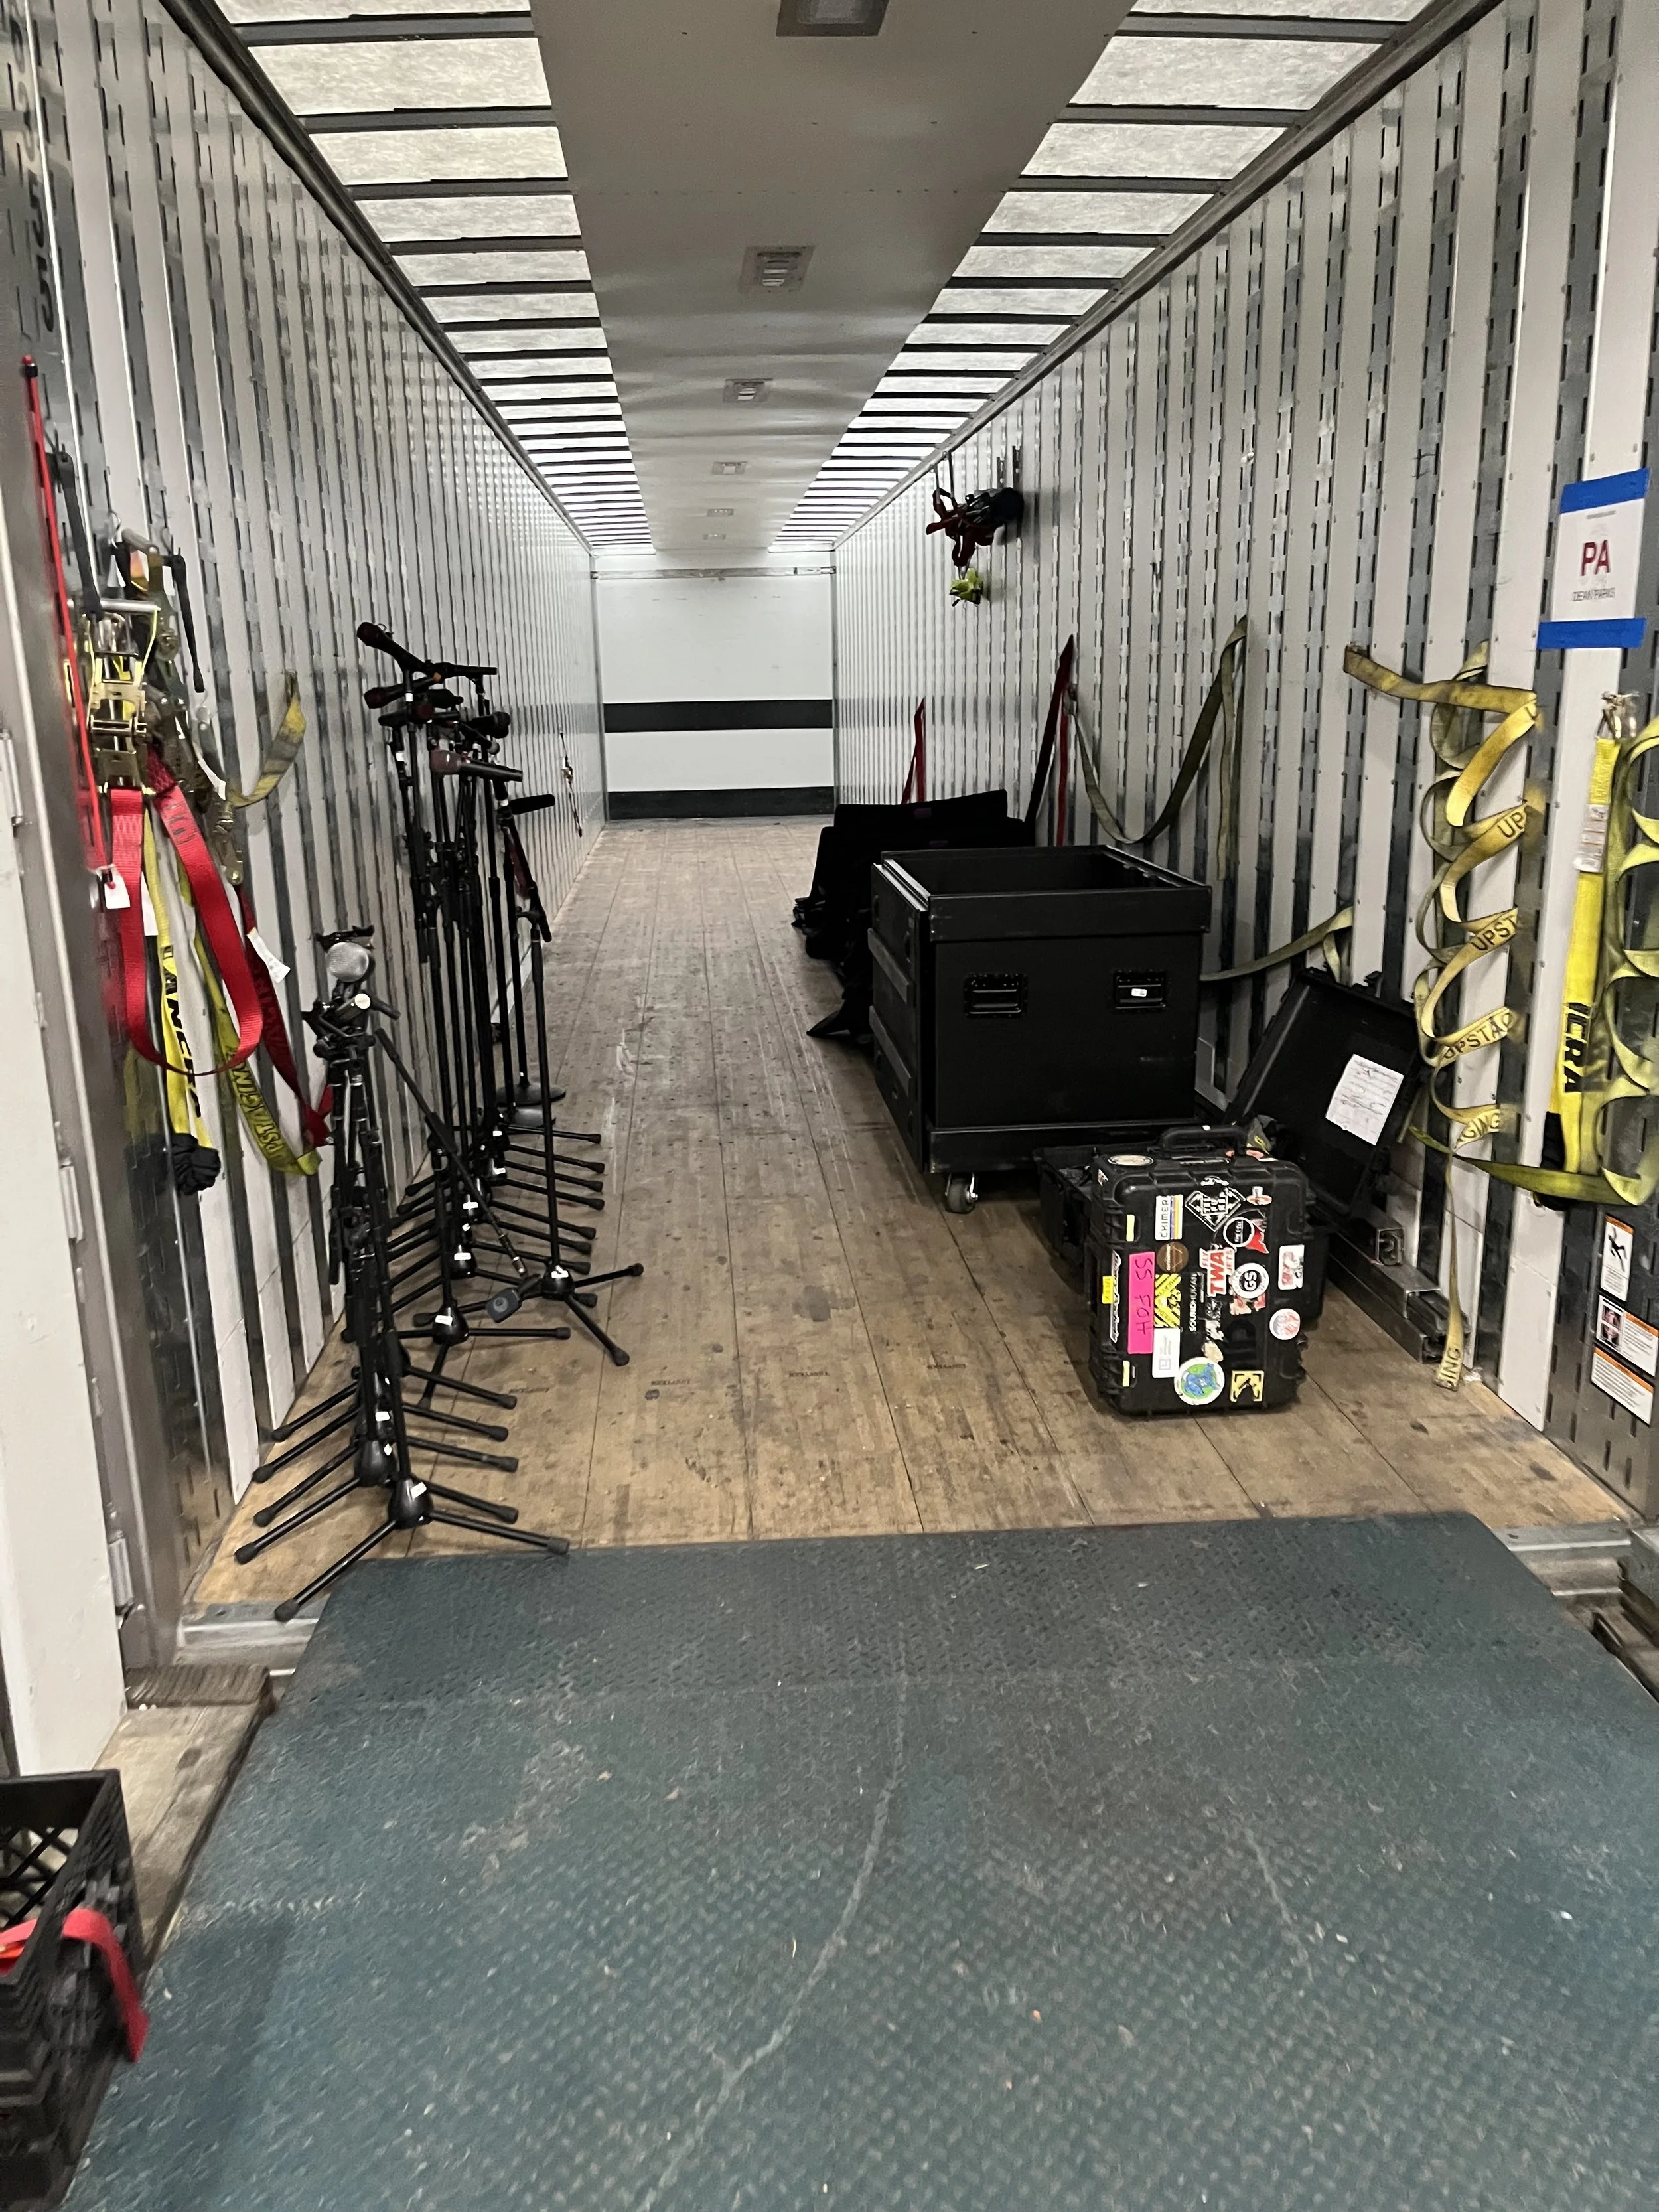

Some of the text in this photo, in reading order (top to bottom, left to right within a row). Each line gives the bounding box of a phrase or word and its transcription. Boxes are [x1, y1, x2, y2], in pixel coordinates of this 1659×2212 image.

[1579, 540, 1611, 576] PA
[1498, 812, 1524, 838] UP
[1210, 1252, 1224, 1294] TWA
[1244, 1270, 1257, 1291] GS
[1135, 1258, 1153, 1335] SS FOH
